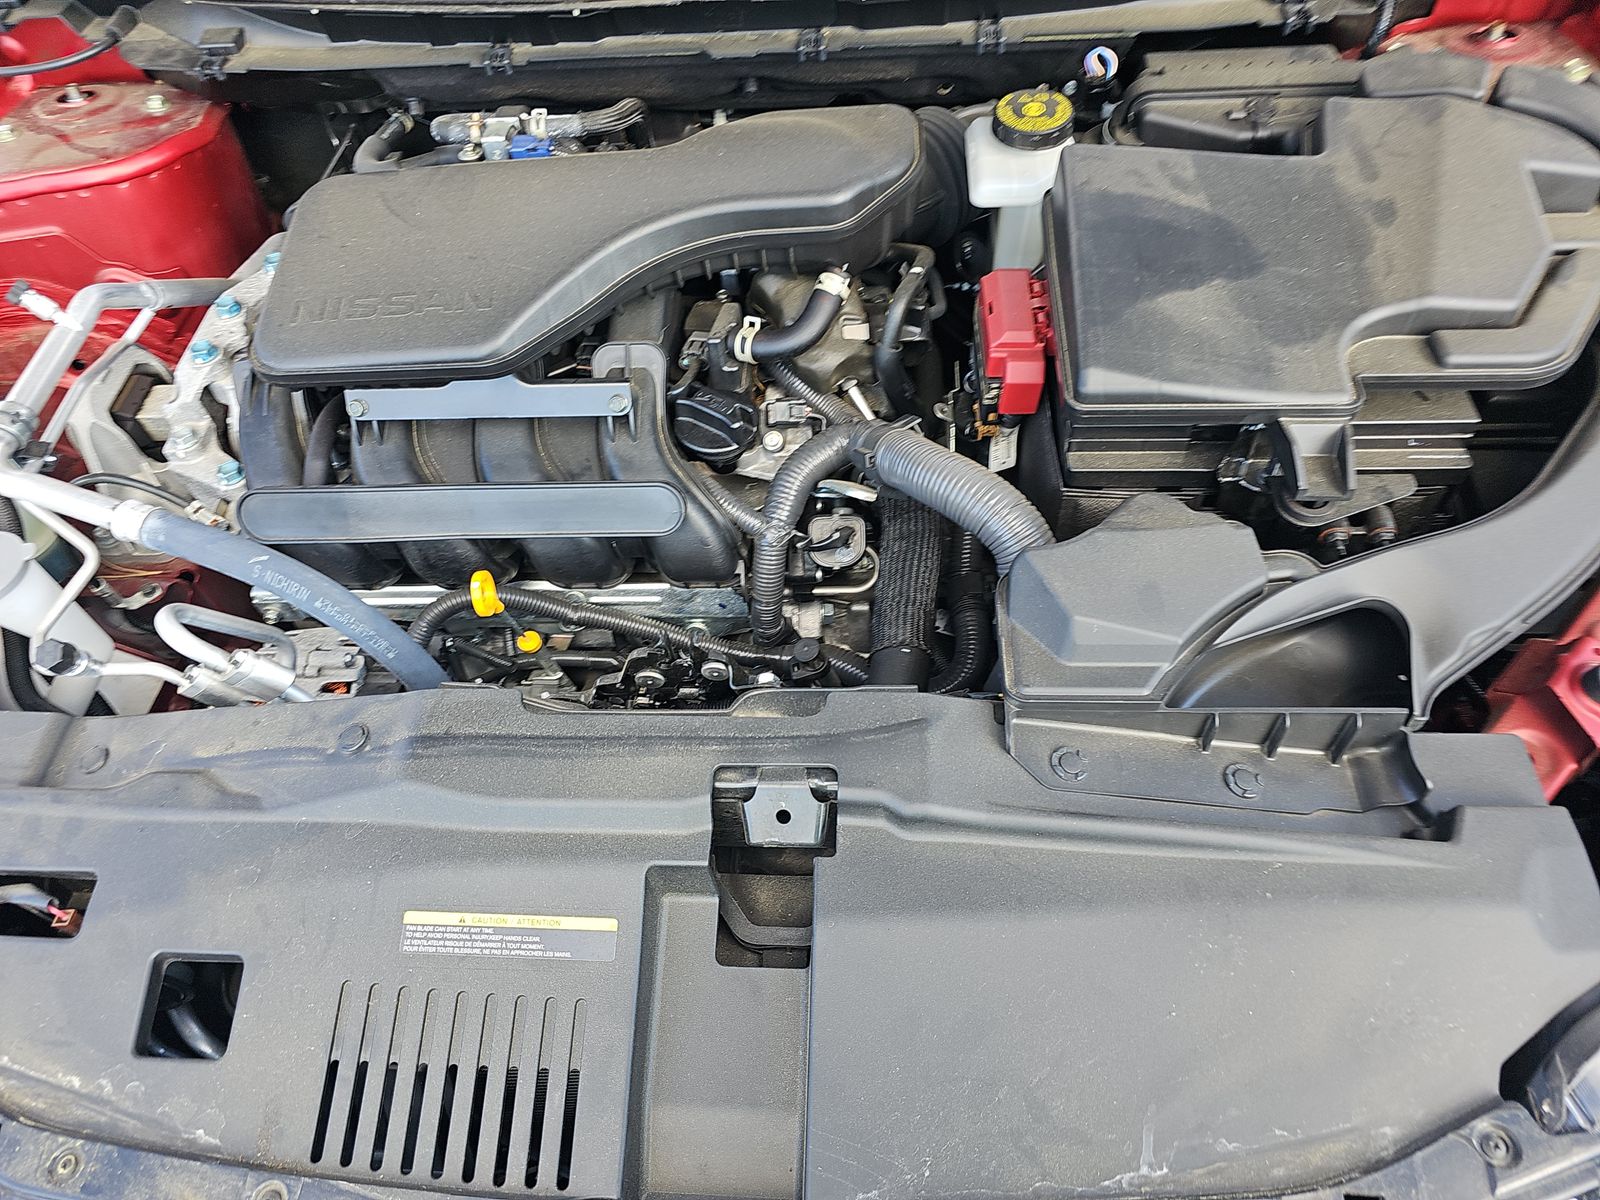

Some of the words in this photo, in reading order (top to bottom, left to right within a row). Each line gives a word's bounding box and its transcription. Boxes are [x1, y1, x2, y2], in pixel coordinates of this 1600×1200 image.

[290, 292, 496, 326] NISSAN
[471, 917, 507, 925] CAUTION
[517, 918, 561, 926] ATTENTION
[472, 940, 501, 948] DÉMARRER
